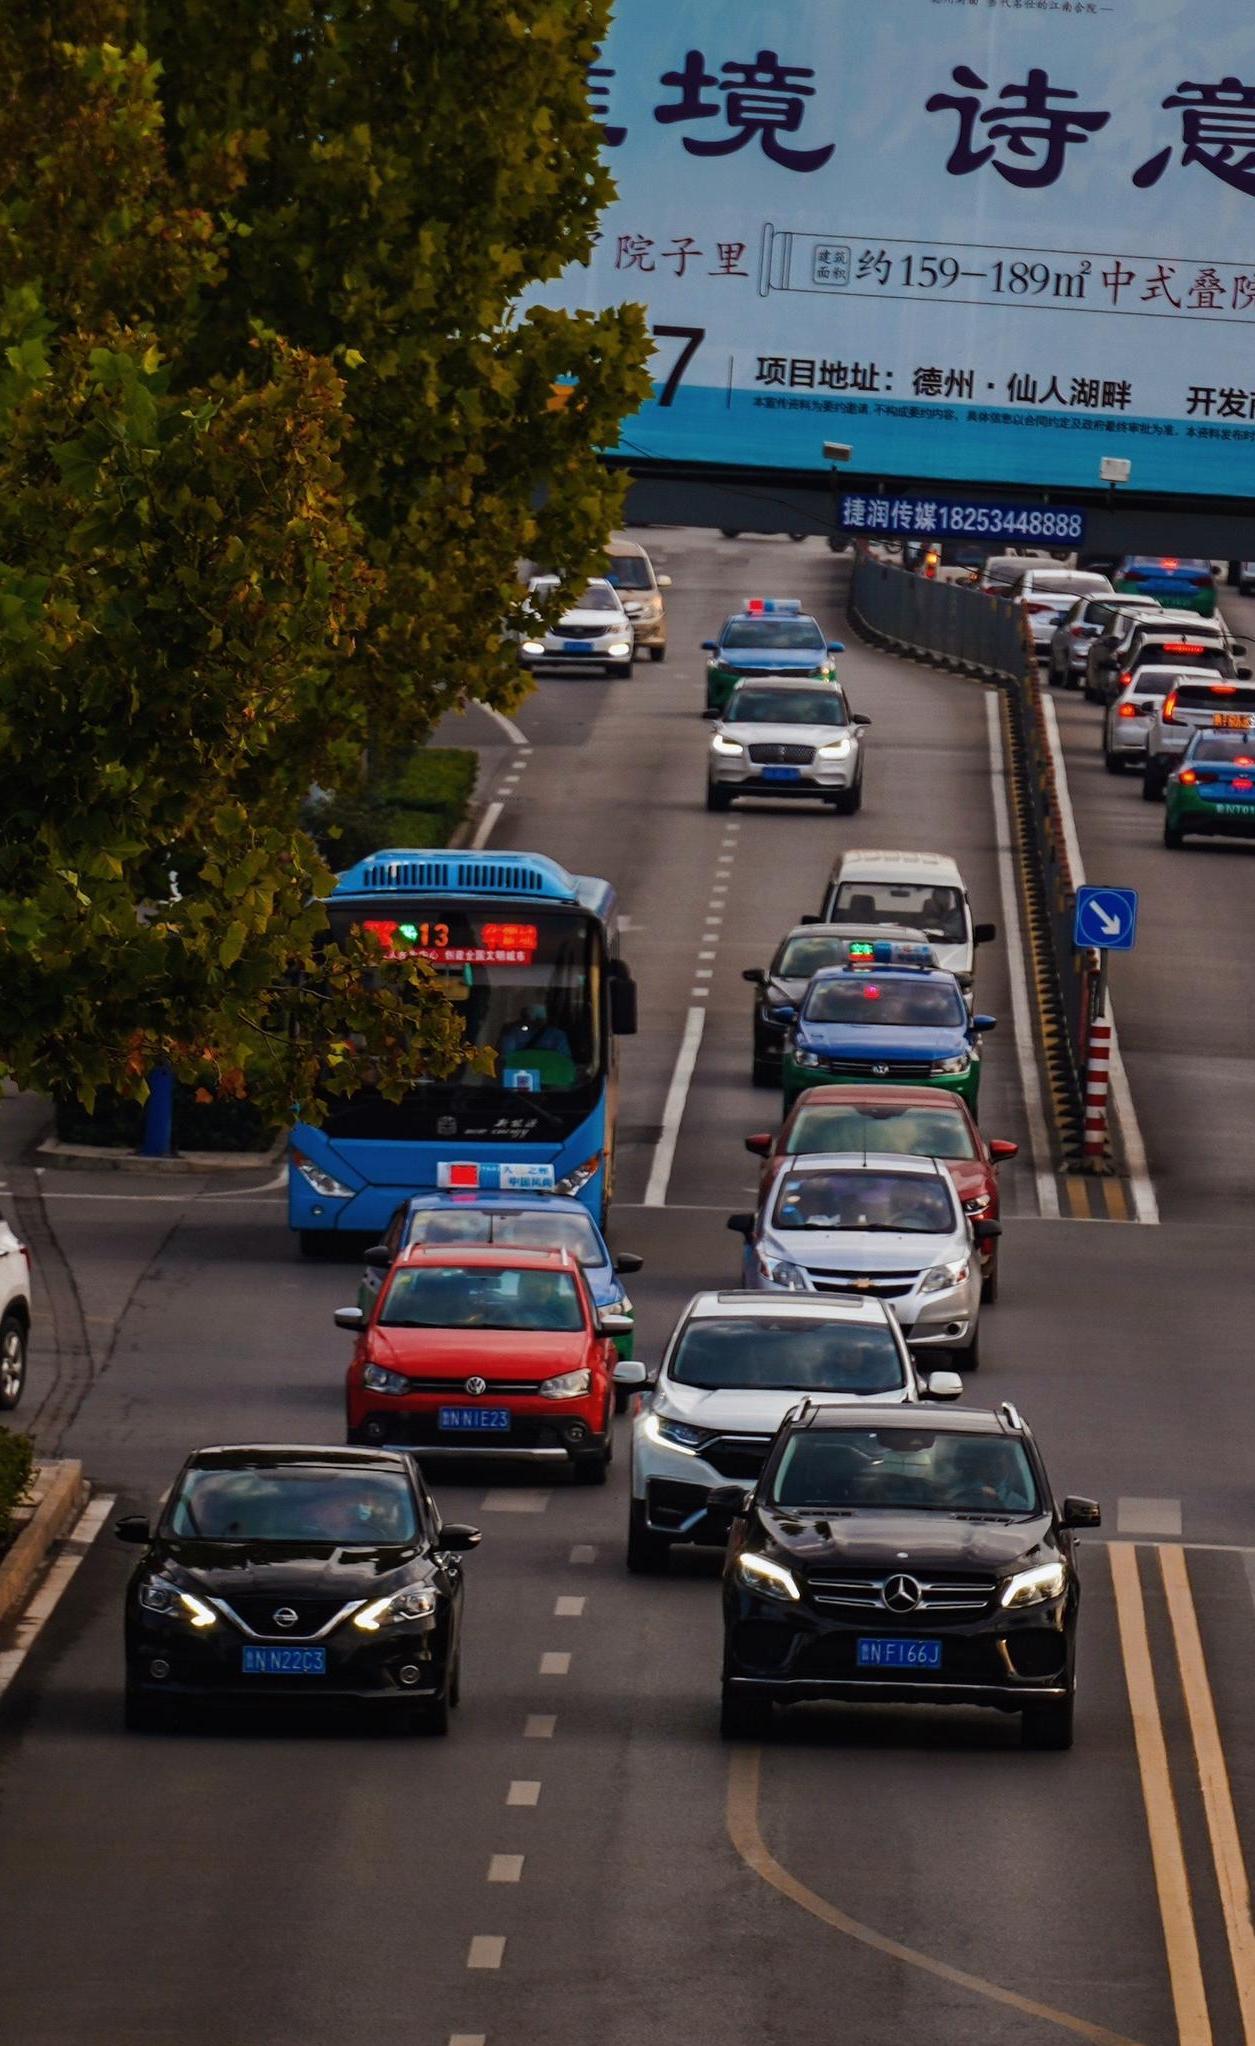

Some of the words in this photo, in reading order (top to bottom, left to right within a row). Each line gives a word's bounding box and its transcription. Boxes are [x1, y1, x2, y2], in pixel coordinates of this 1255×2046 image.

[587, 231, 749, 277] 院子里
[419, 923, 449, 948] 13
